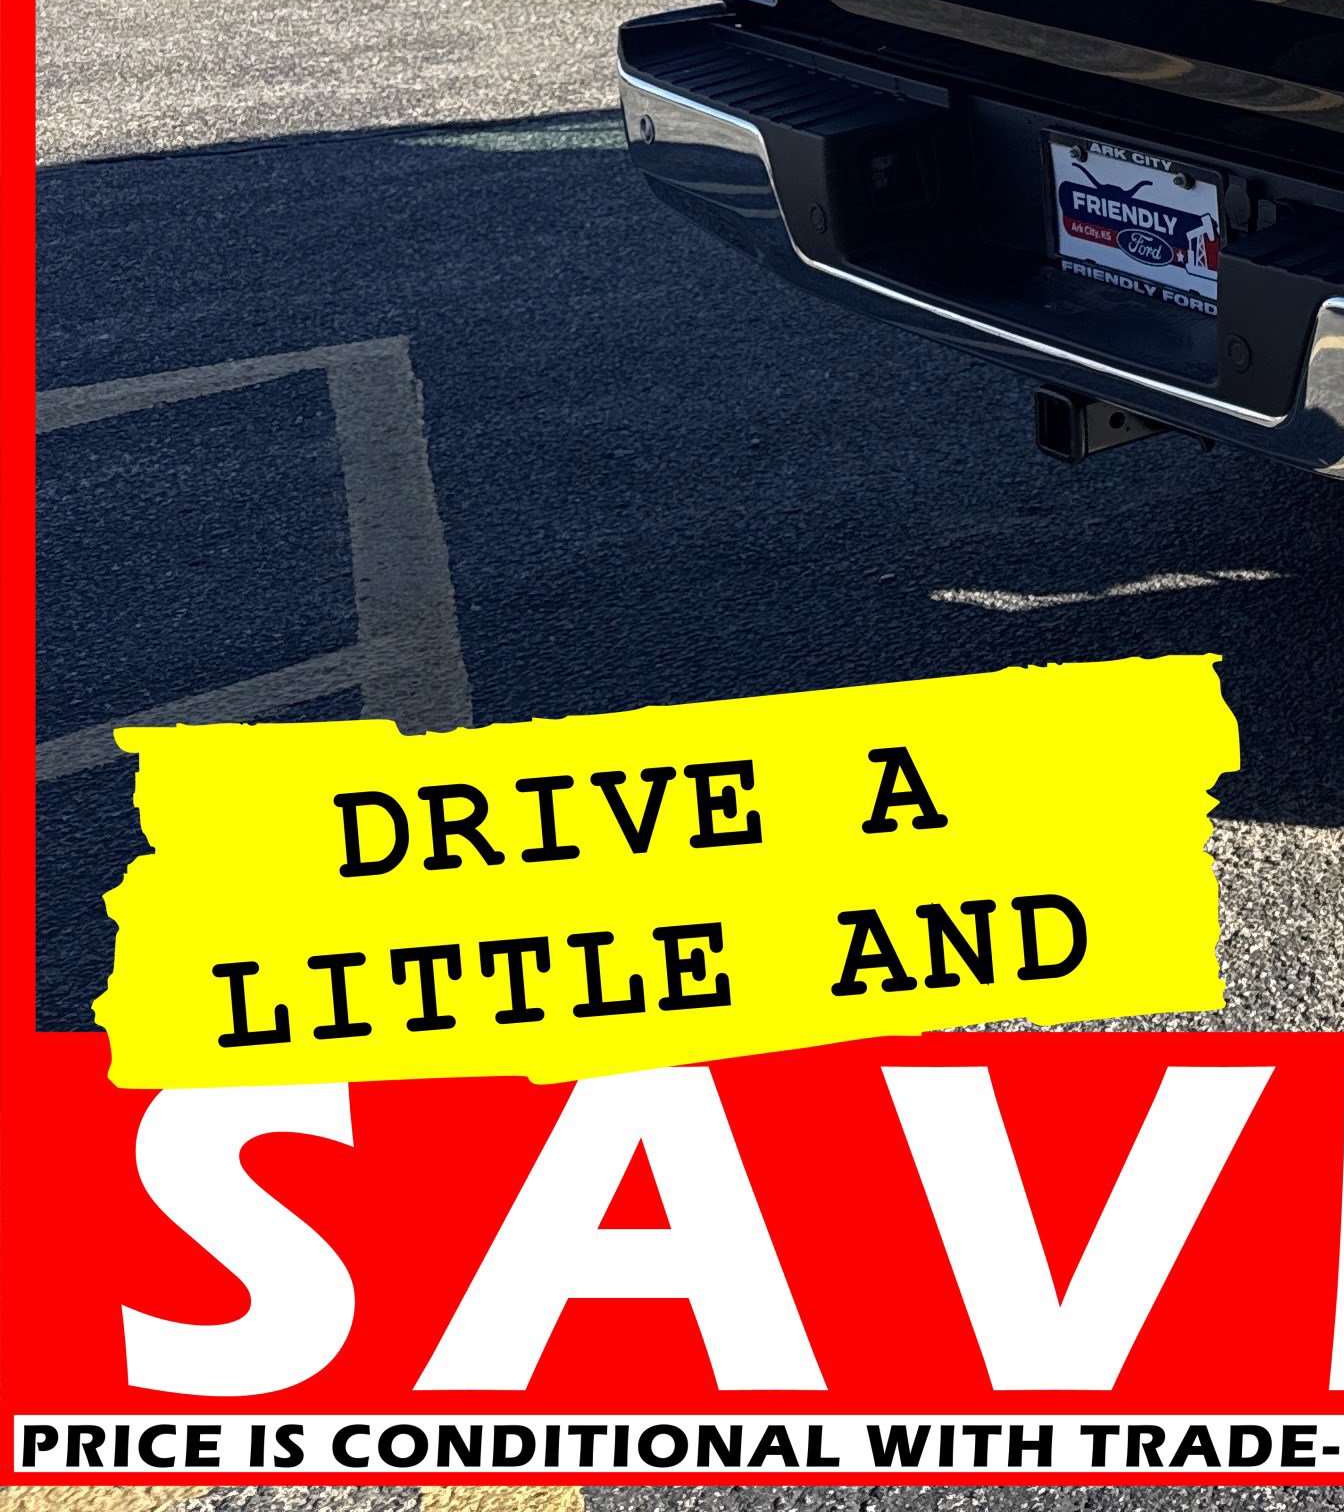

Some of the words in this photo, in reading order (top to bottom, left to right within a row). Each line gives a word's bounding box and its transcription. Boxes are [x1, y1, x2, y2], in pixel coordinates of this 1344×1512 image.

[1090, 142, 1127, 161] ARK
[1131, 152, 1172, 172] CITY
[1072, 190, 1178, 236] FRIENDLY
[1128, 230, 1163, 261] Ford
[1061, 260, 1158, 297] FRIENDLY
[1162, 289, 1218, 317] FORD
